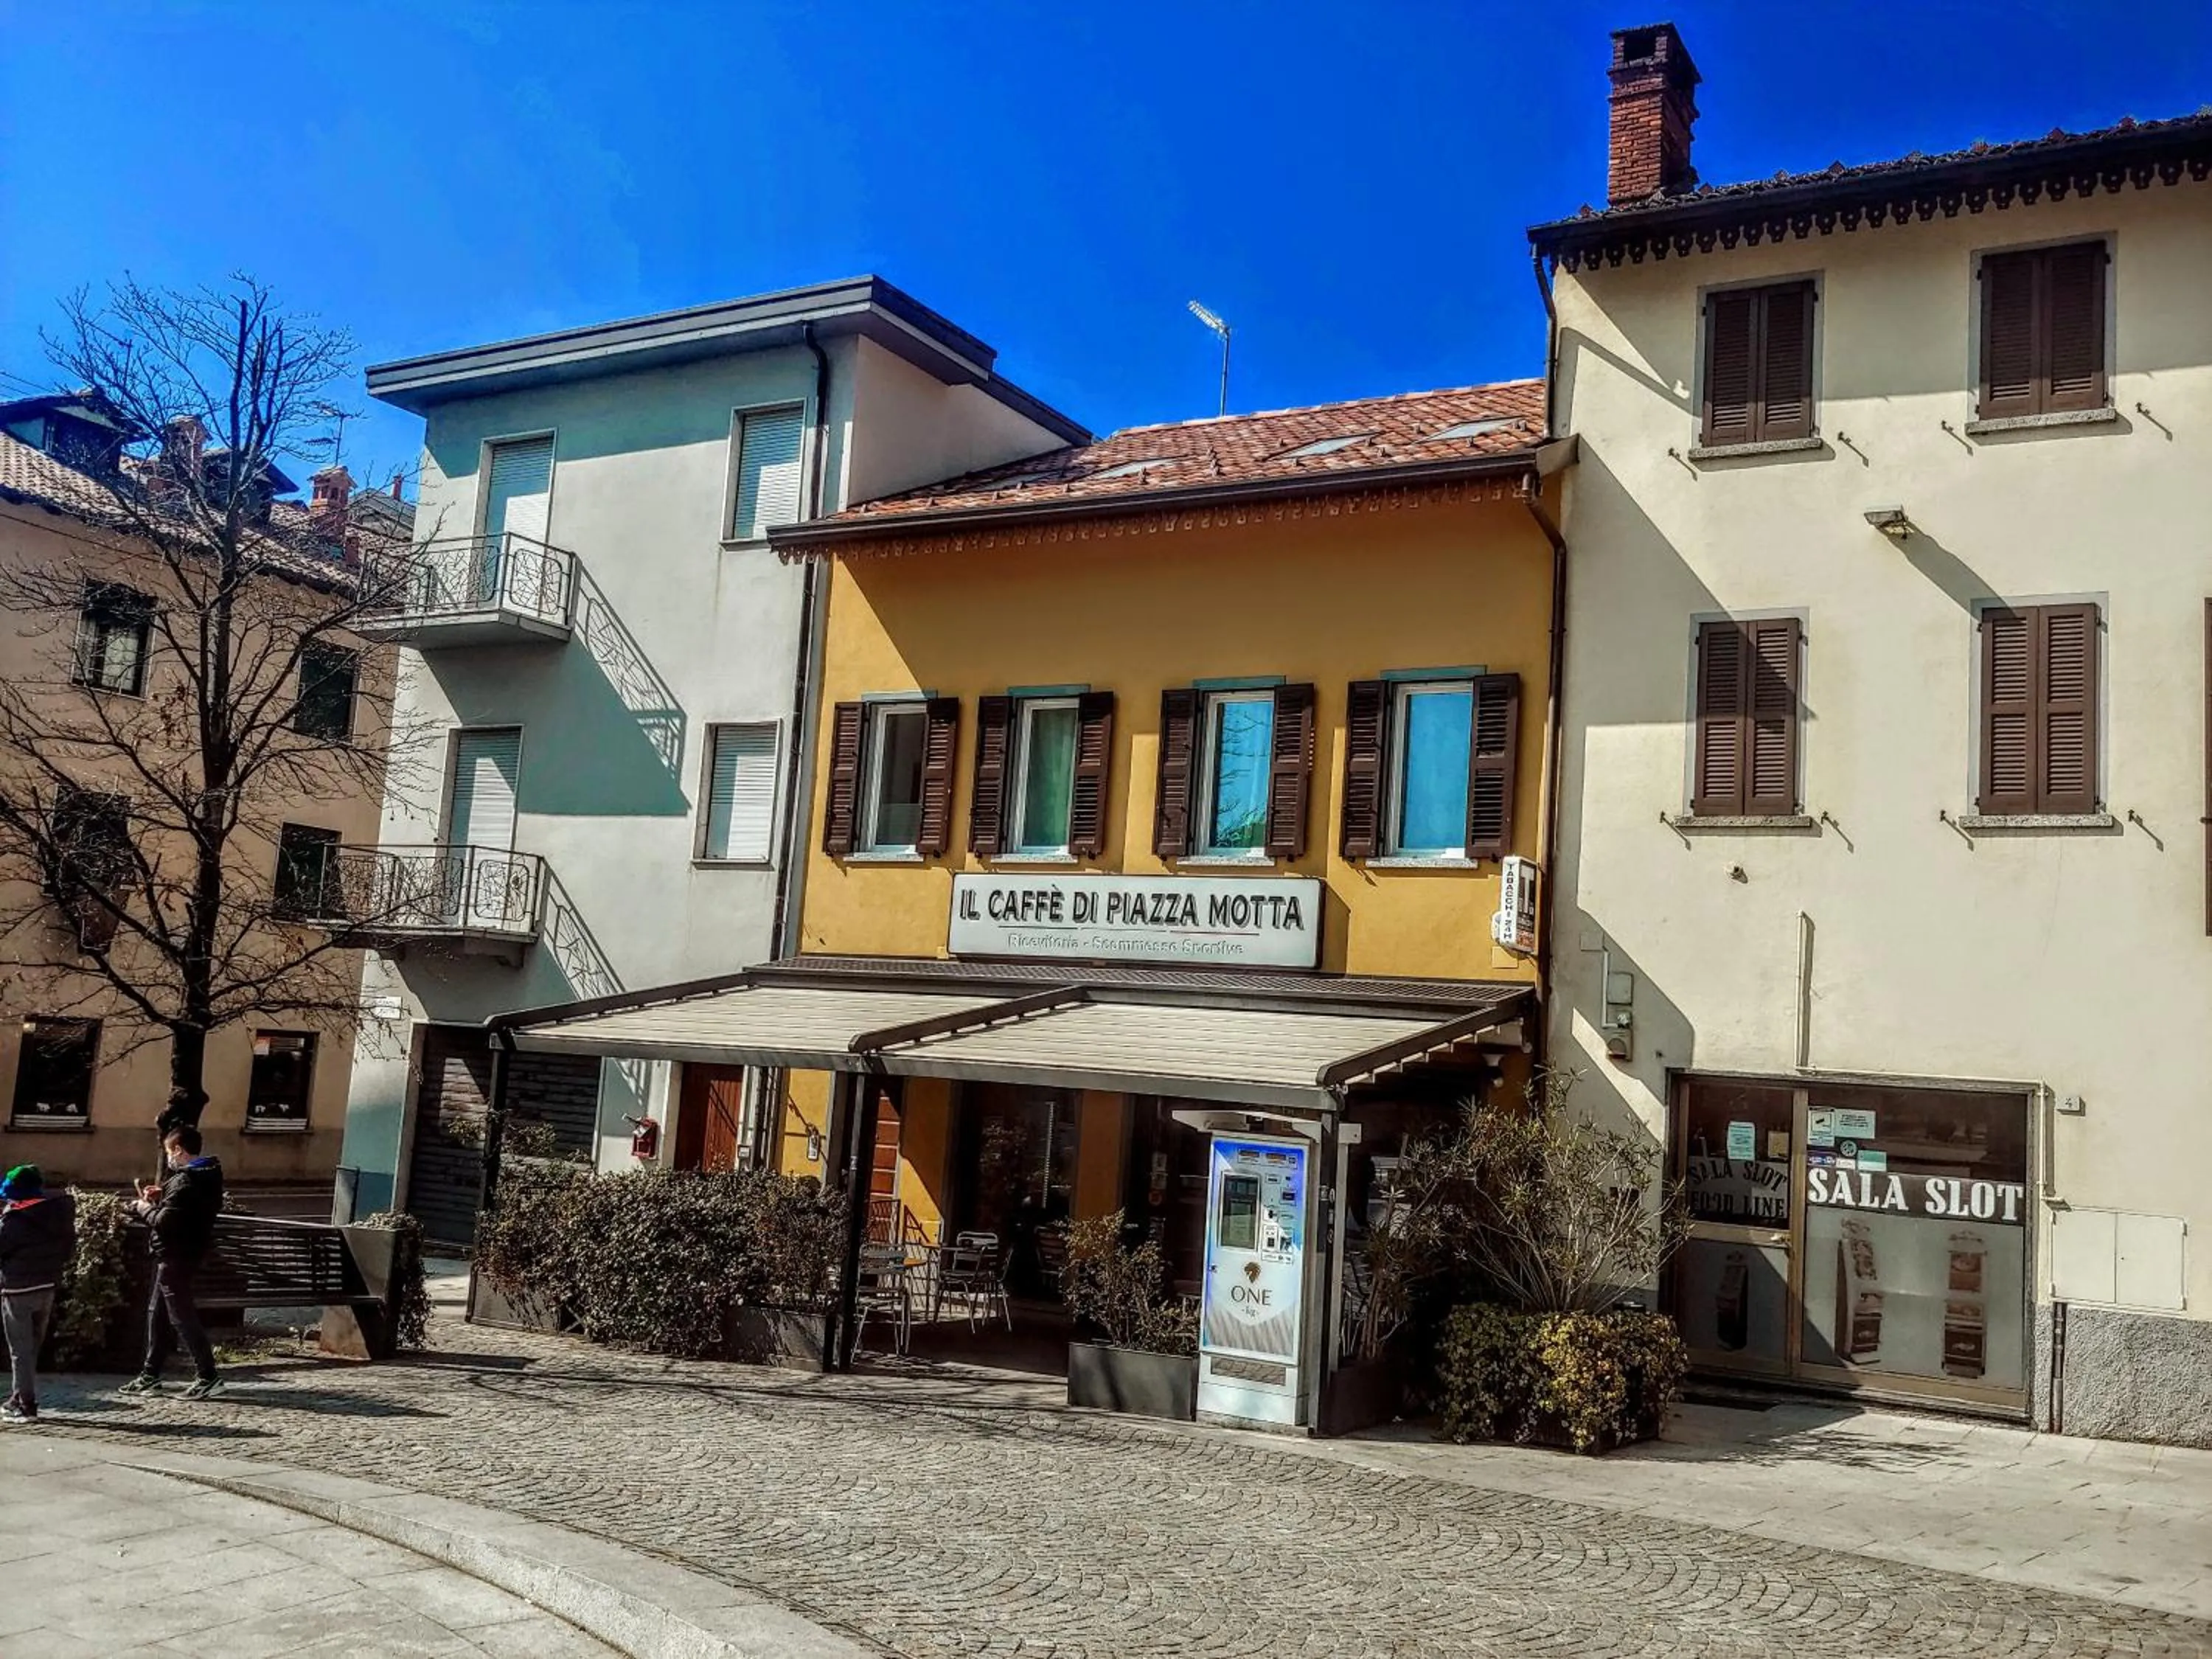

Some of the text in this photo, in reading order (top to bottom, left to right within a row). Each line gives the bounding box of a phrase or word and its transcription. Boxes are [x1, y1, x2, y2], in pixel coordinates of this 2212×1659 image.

[959, 883, 1304, 931] IL CAFFÈ DI PIAZZA MOTTA
[1505, 863, 1514, 918] TABACCHI
[1690, 1160, 1787, 1192] SALA SLOT
[1807, 1167, 2025, 1221] SALA SLOT
[1744, 1195, 1785, 1219] LINE
[1231, 1285, 1273, 1306] ONE
